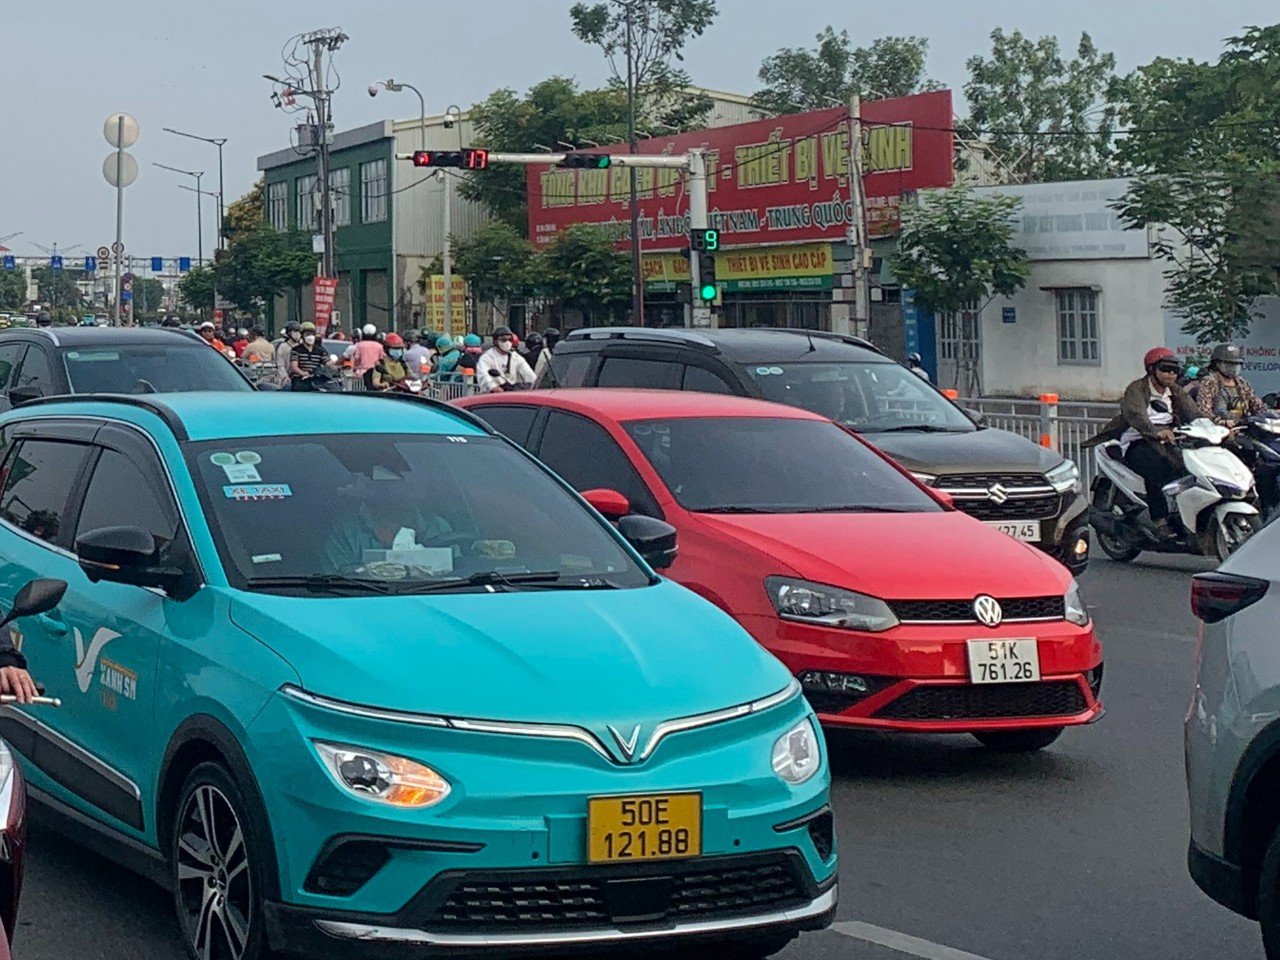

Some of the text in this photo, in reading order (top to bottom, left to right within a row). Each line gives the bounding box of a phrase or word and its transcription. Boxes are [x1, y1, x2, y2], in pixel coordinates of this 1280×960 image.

[795, 134, 818, 190] BỊ
[767, 203, 812, 231] TRUNG
[704, 230, 717, 249] 9
[998, 524, 1034, 538] 27.45
[988, 642, 1019, 661] 51K
[978, 662, 1033, 681] 761.26
[621, 799, 669, 826] 50E
[604, 828, 689, 859] 121.88
